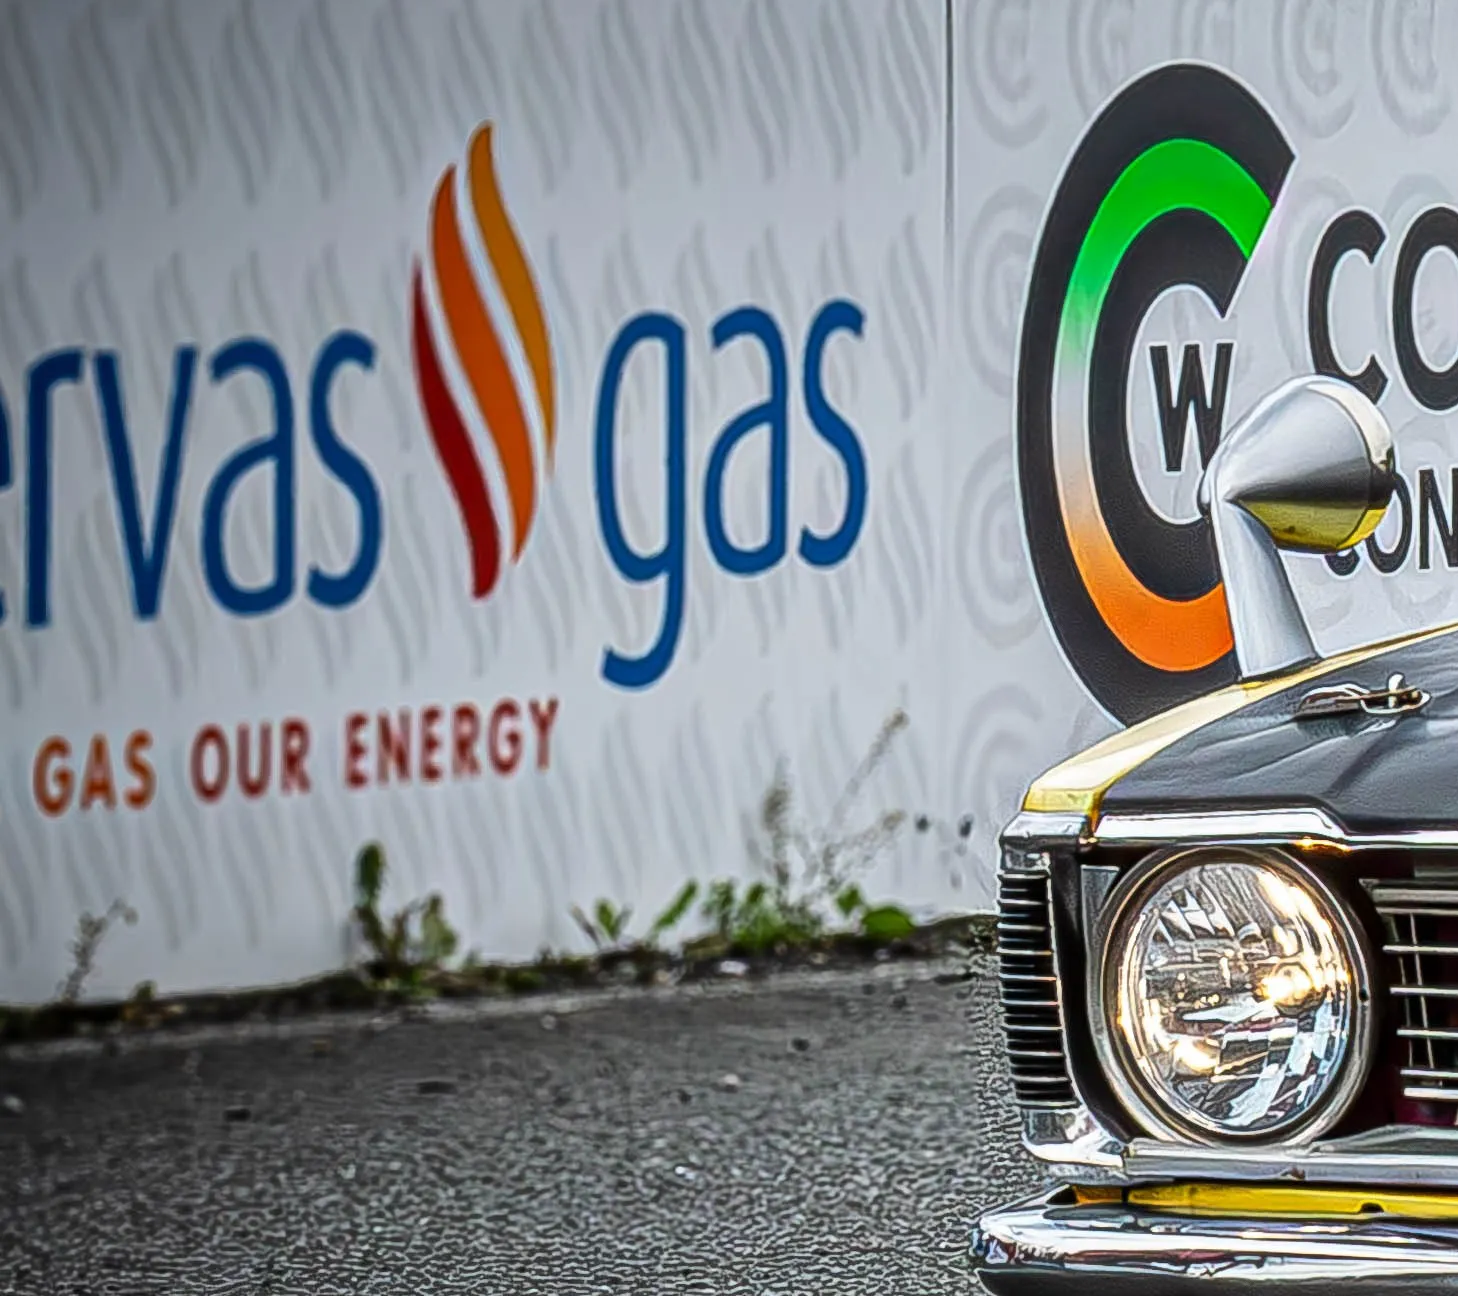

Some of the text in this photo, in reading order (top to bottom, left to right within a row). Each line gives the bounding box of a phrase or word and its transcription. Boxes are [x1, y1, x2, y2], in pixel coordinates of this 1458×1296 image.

[0, 299, 868, 689] rvas gas
[33, 698, 560, 818] GAS OUR ENERGY
